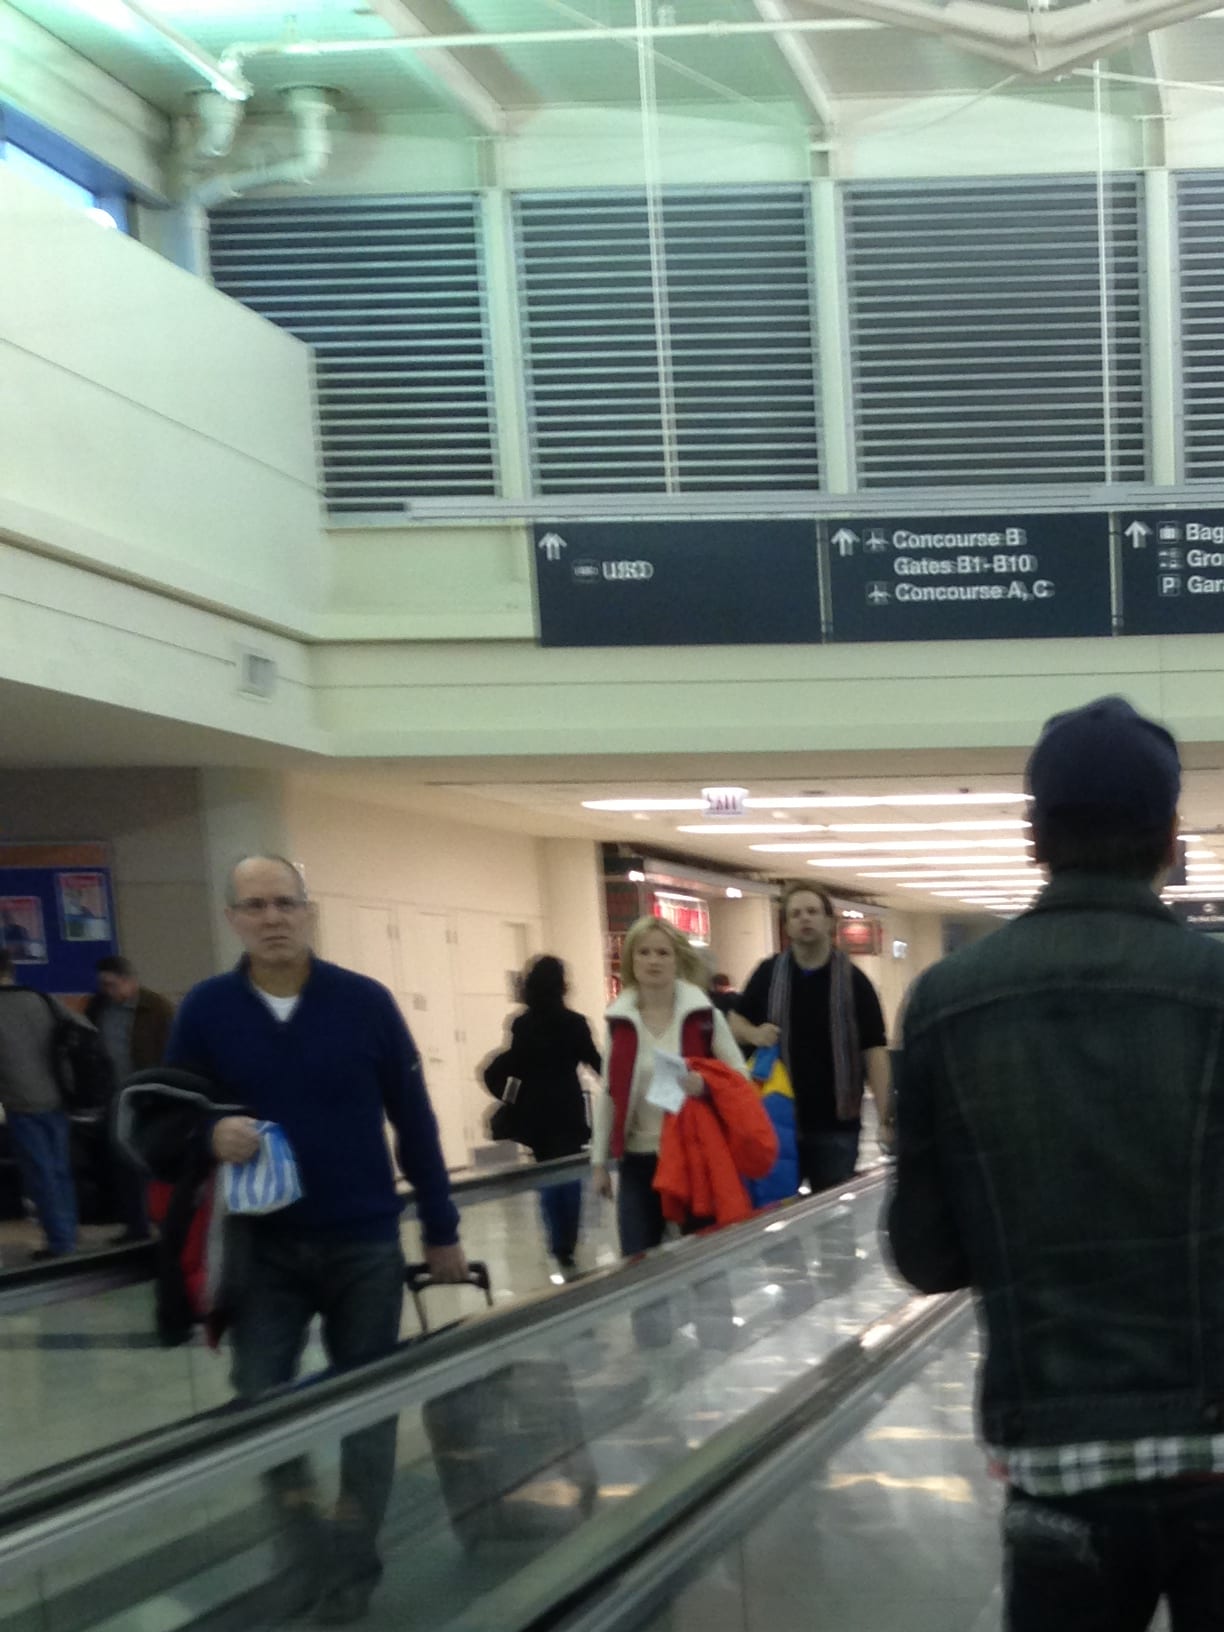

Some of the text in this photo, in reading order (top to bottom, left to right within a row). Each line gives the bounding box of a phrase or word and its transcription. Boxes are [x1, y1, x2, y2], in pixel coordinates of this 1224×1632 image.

[892, 527, 1027, 550] Concourse B
[894, 554, 1037, 575] Gates B1-B10
[895, 582, 1004, 601] Concourse
[1032, 579, 1054, 598] C
